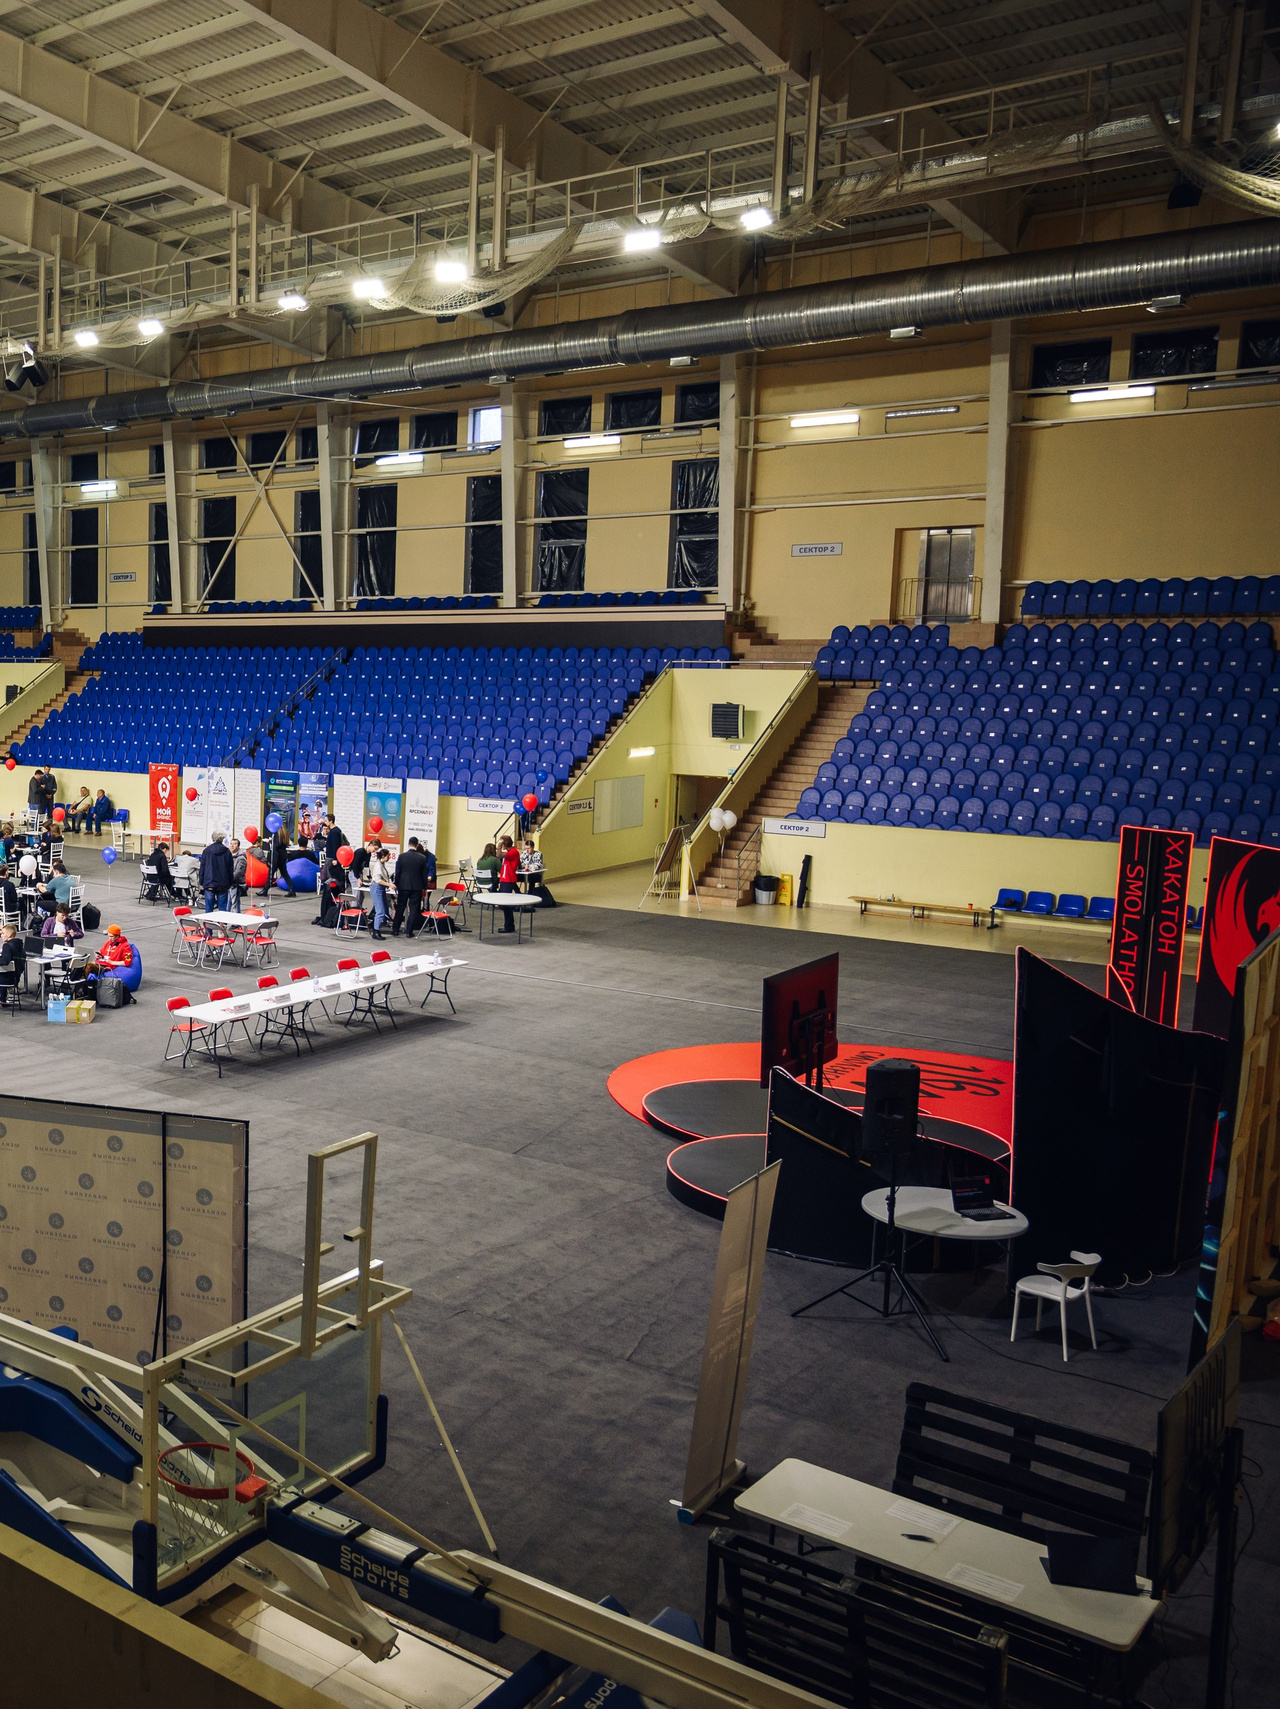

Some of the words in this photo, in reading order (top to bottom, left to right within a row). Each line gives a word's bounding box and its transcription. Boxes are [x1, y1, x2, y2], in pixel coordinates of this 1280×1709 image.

[799, 546, 829, 554] СЕКТОР
[830, 545, 835, 553] 2
[156, 807, 172, 815] МОЙ
[779, 824, 805, 832] СЕКТОР
[1157, 836, 1185, 955] ХАКАТОН
[1118, 863, 1144, 1001] SMOLATHO
[103, 1404, 144, 1446] Scheld
[158, 1450, 192, 1486] ports
[340, 1545, 410, 1588] Schelde
[340, 1557, 410, 1599] Sports
[584, 1678, 618, 1709] ports
